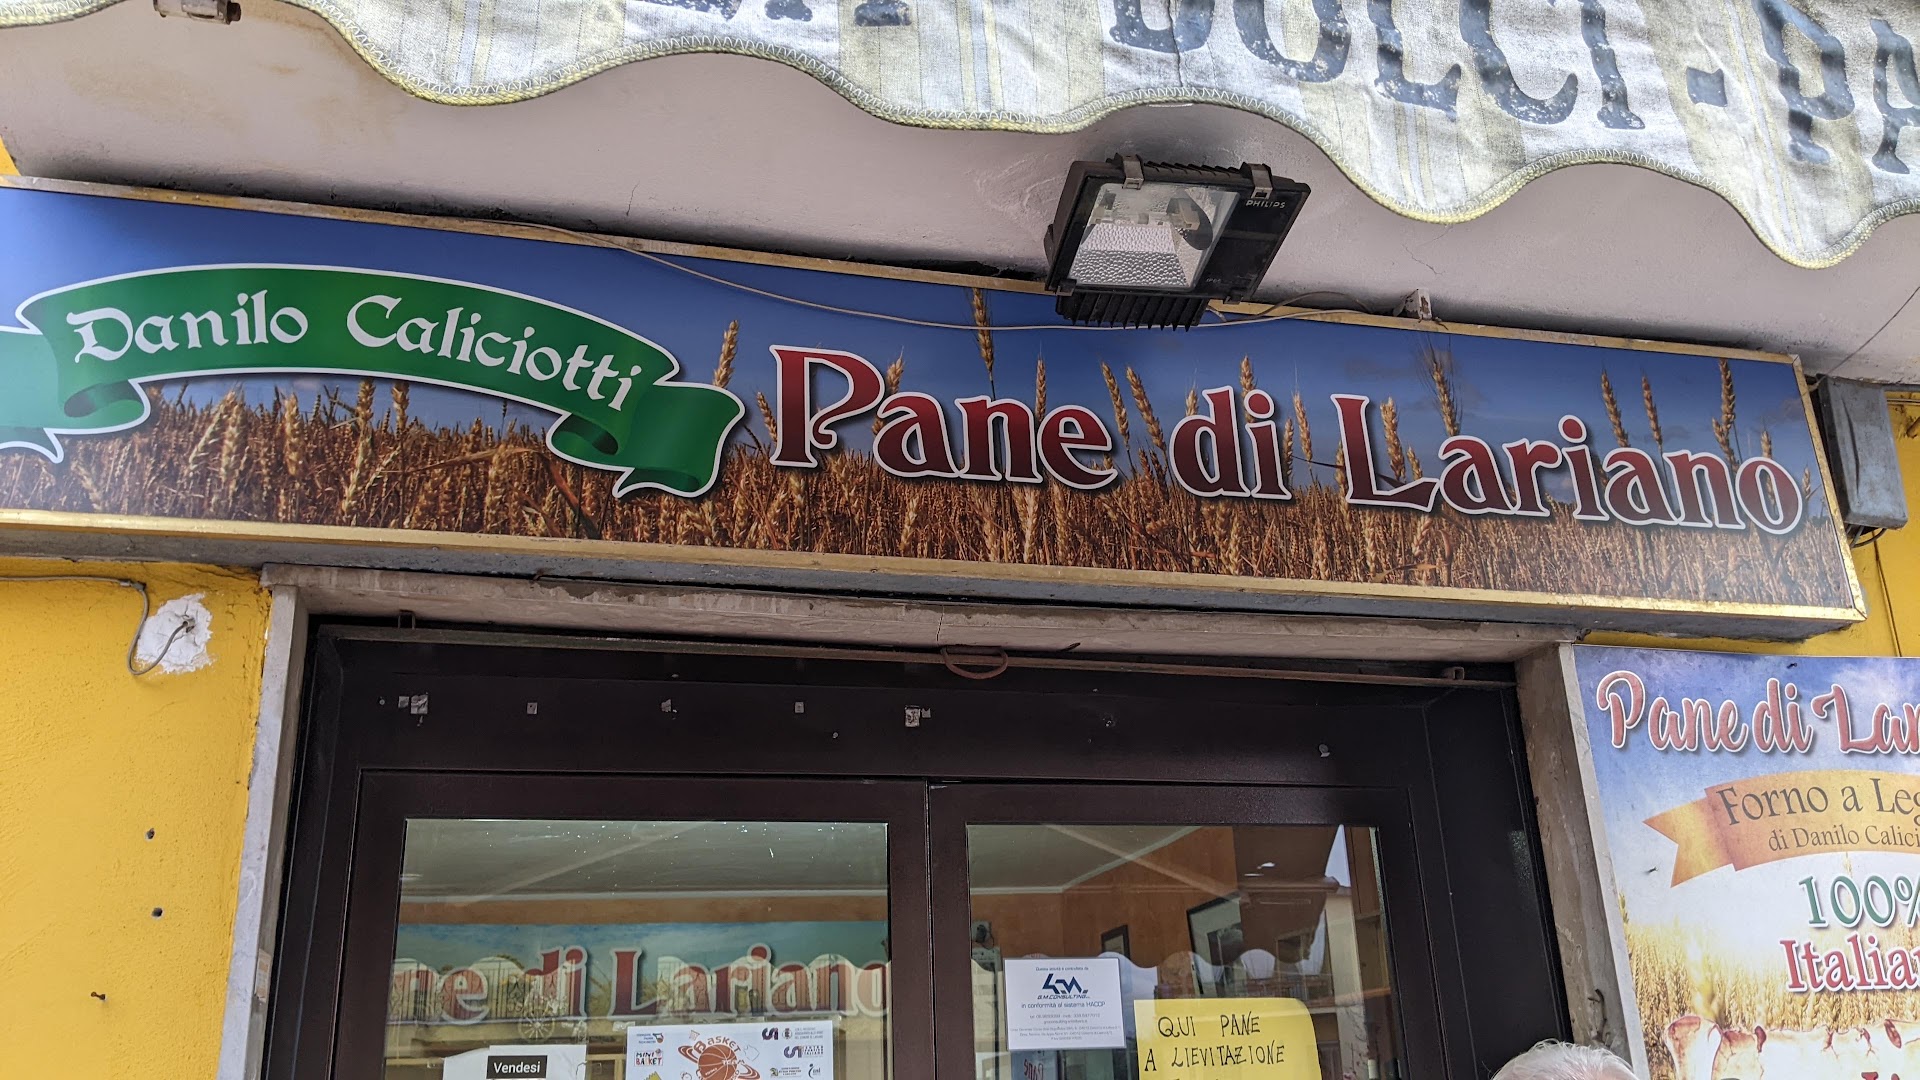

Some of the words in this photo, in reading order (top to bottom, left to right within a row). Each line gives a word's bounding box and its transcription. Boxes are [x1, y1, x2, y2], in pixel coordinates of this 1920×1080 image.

[1245, 199, 1286, 209] PHILIPS
[66, 290, 308, 364] Danilo
[346, 294, 642, 412] Caliciotti
[769, 345, 1118, 490] Pane
[1168, 386, 1292, 500] di
[1330, 394, 1802, 535] Lariano
[1597, 670, 1748, 752] Pane
[1752, 678, 1815, 754] di
[1716, 786, 1829, 826] Forno
[1840, 785, 1864, 812] a
[1768, 829, 1789, 852] di
[1793, 824, 1859, 850] Danilo
[1779, 931, 1920, 991] Italia
[519, 945, 588, 1021] di
[607, 943, 888, 1020] Lariano
[1157, 1015, 1196, 1038] QUI
[1220, 1011, 1261, 1037] PANE
[493, 1061, 541, 1074] Vendesi
[1144, 1048, 1157, 1072] A
[1171, 1038, 1286, 1068] LIEVITAZIONE
